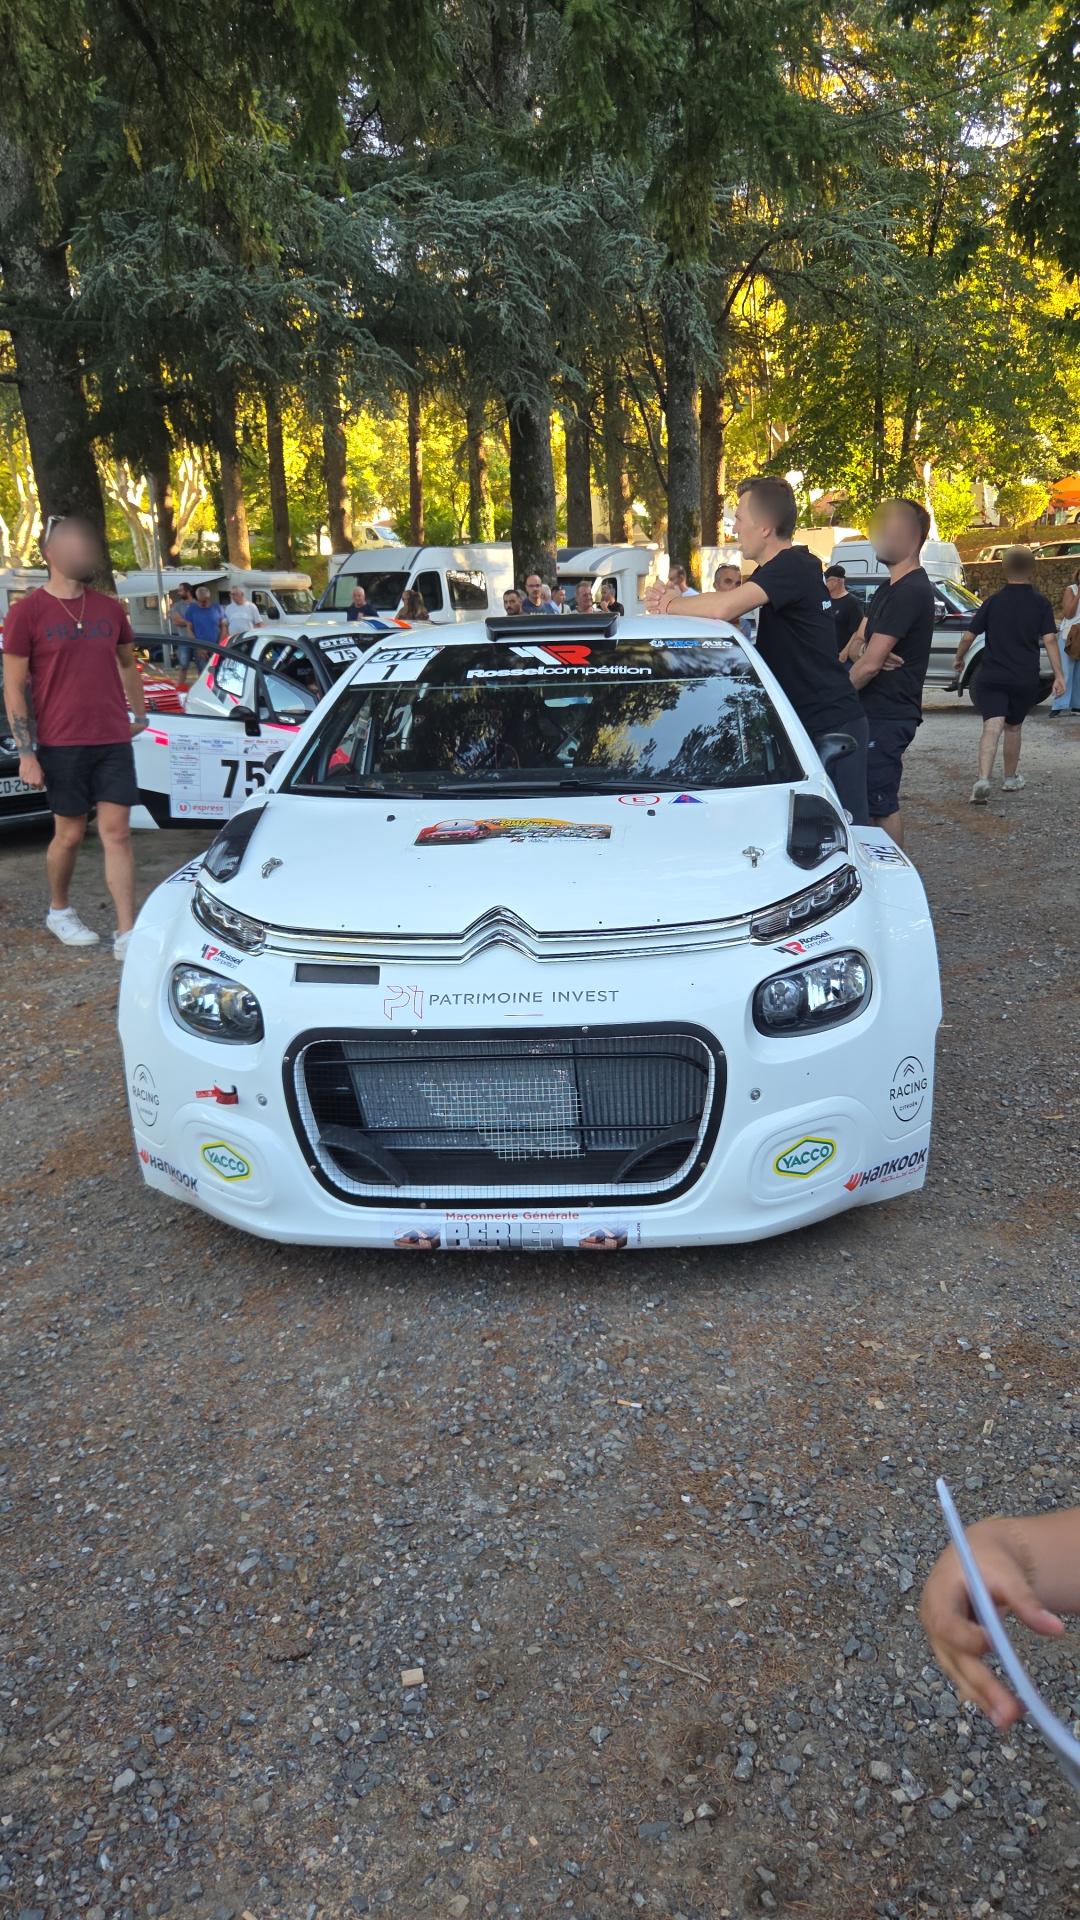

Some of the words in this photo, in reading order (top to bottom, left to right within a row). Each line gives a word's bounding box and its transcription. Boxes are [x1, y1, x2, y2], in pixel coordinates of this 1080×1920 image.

[334, 649, 356, 661] 75
[382, 664, 399, 680] 1
[220, 759, 266, 798] 75
[429, 991, 543, 1006] PATRIMOINE
[552, 990, 620, 1003] INVEST
[131, 1085, 160, 1106] RACING
[889, 1078, 928, 1101] RACING
[207, 1150, 246, 1174] YACCO
[782, 1145, 830, 1169] YACCO
[445, 1211, 519, 1222] Maçonnerie
[523, 1210, 580, 1221] Générale
[445, 1222, 564, 1248] PERIER
